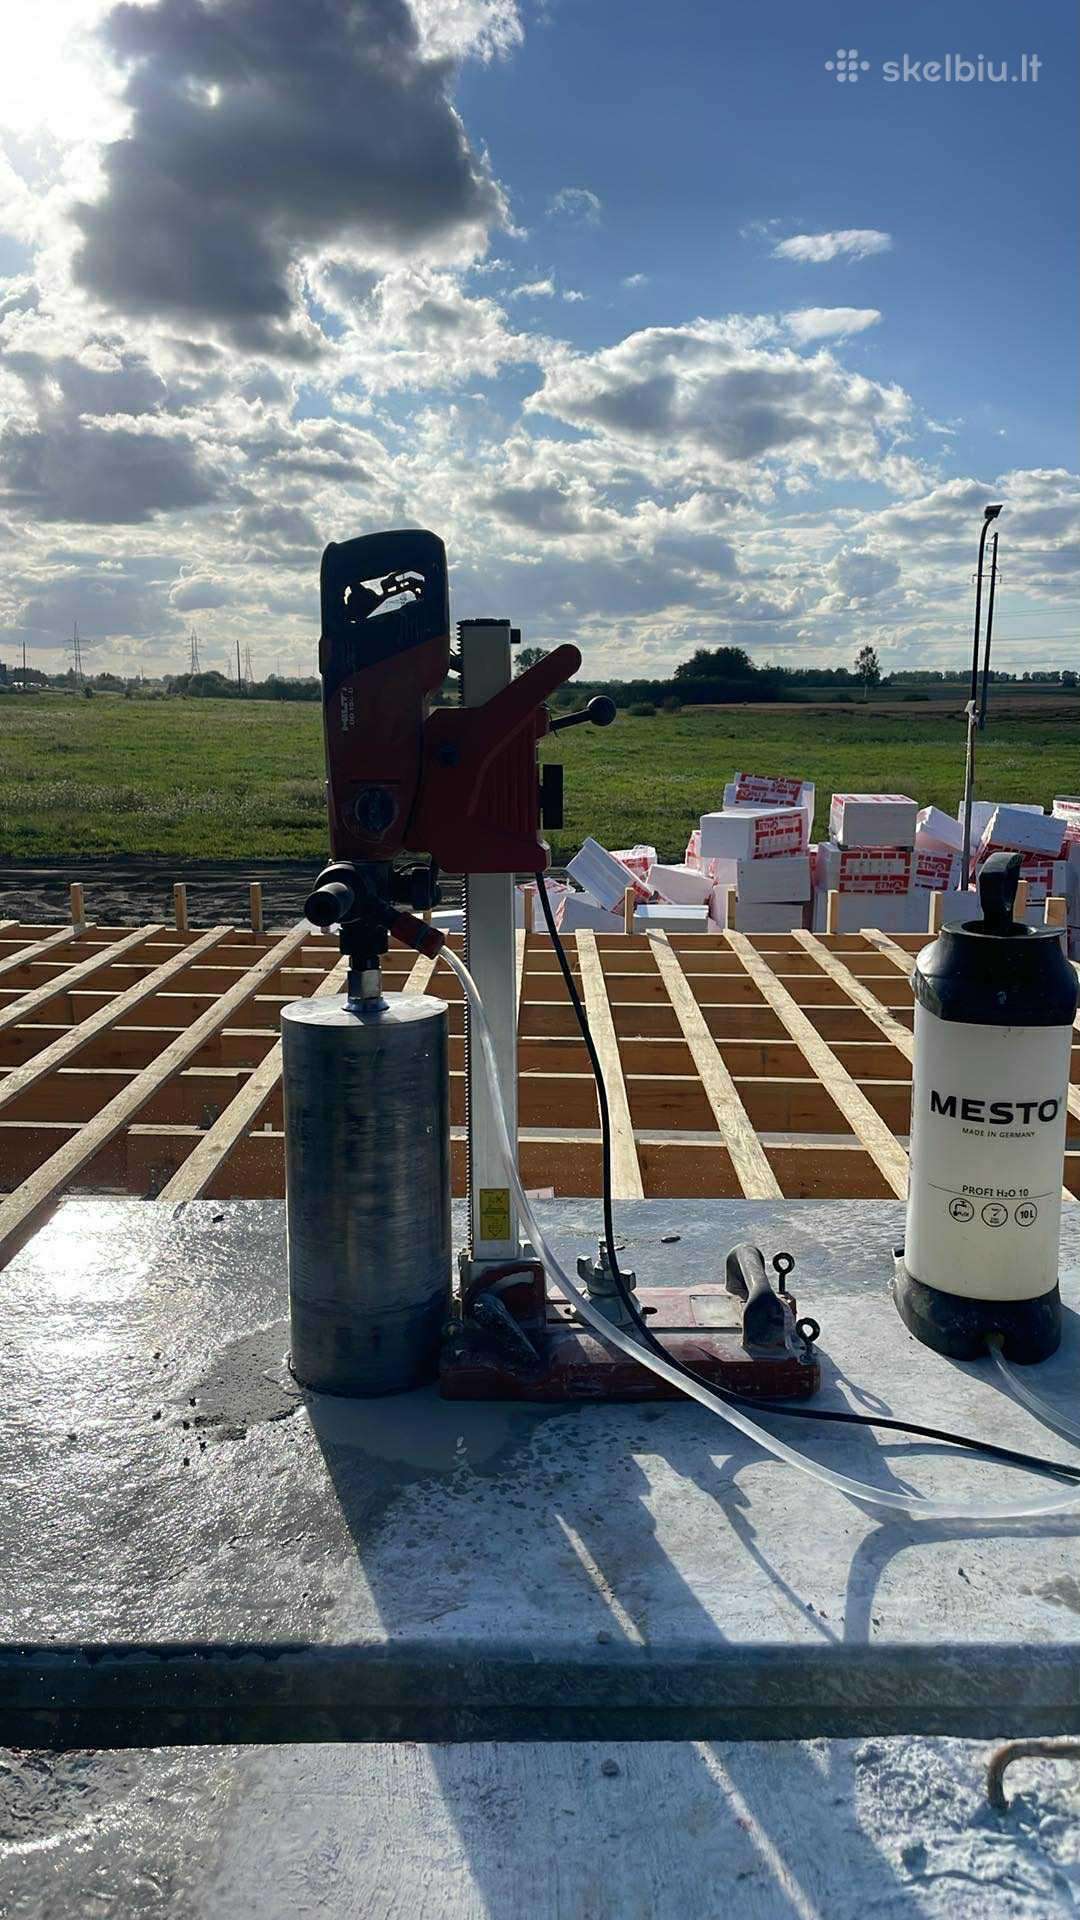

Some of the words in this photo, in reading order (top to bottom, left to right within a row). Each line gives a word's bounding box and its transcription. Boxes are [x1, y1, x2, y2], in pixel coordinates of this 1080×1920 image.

[930, 1090, 1058, 1125] MESTO
[961, 1127, 985, 1137] MADE
[987, 1129, 997, 1138] IN
[961, 1185, 993, 1197] PROFI
[1019, 1188, 1029, 1197] 10
